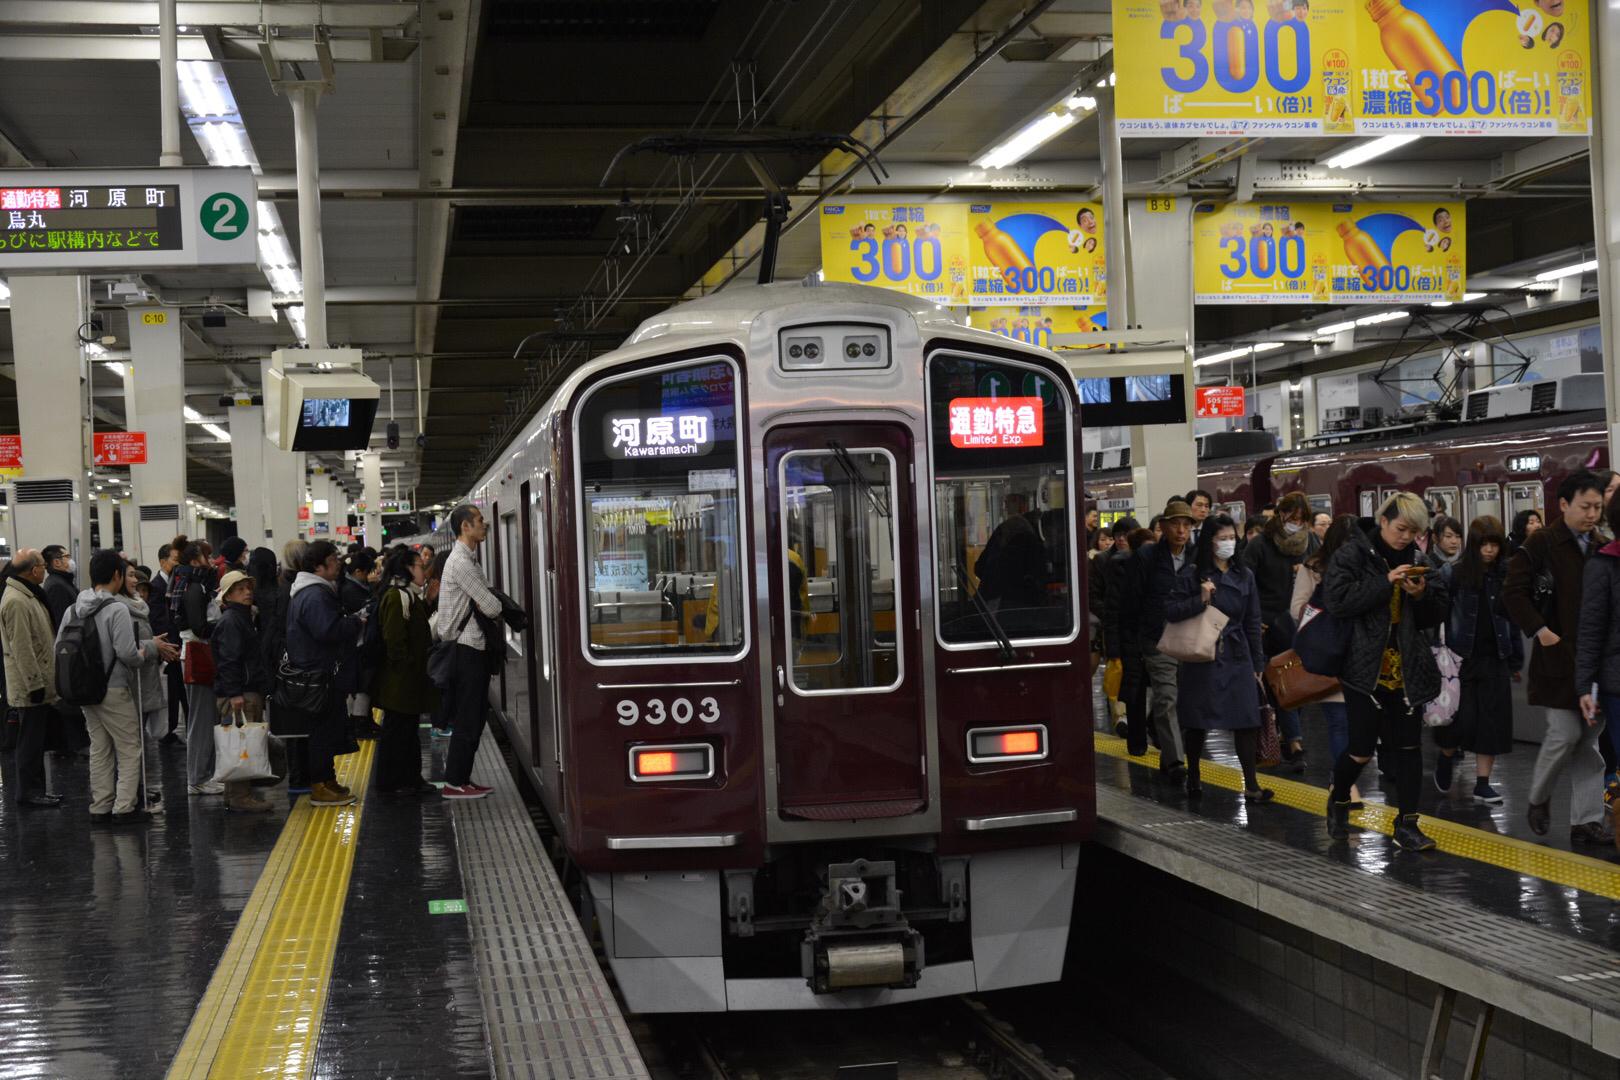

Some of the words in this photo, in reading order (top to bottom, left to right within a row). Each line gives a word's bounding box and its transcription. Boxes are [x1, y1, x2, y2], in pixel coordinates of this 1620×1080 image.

[1160, 17, 1311, 93] 300
[1414, 70, 1496, 115] 300
[1, 190, 60, 208] 通勤特急
[69, 188, 165, 208] 河原町
[212, 198, 238, 233] 2
[850, 237, 942, 282] 300
[1220, 235, 1306, 279] 300
[1005, 266, 1055, 293] 300
[1362, 265, 1410, 291] 300
[611, 415, 708, 447] 河原町
[951, 405, 1037, 435] 通勤特急
[624, 443, 698, 457] Kawaramachi
[964, 434, 998, 445] Limited
[1002, 435, 1024, 445] Exp.
[616, 696, 721, 726] 9303
